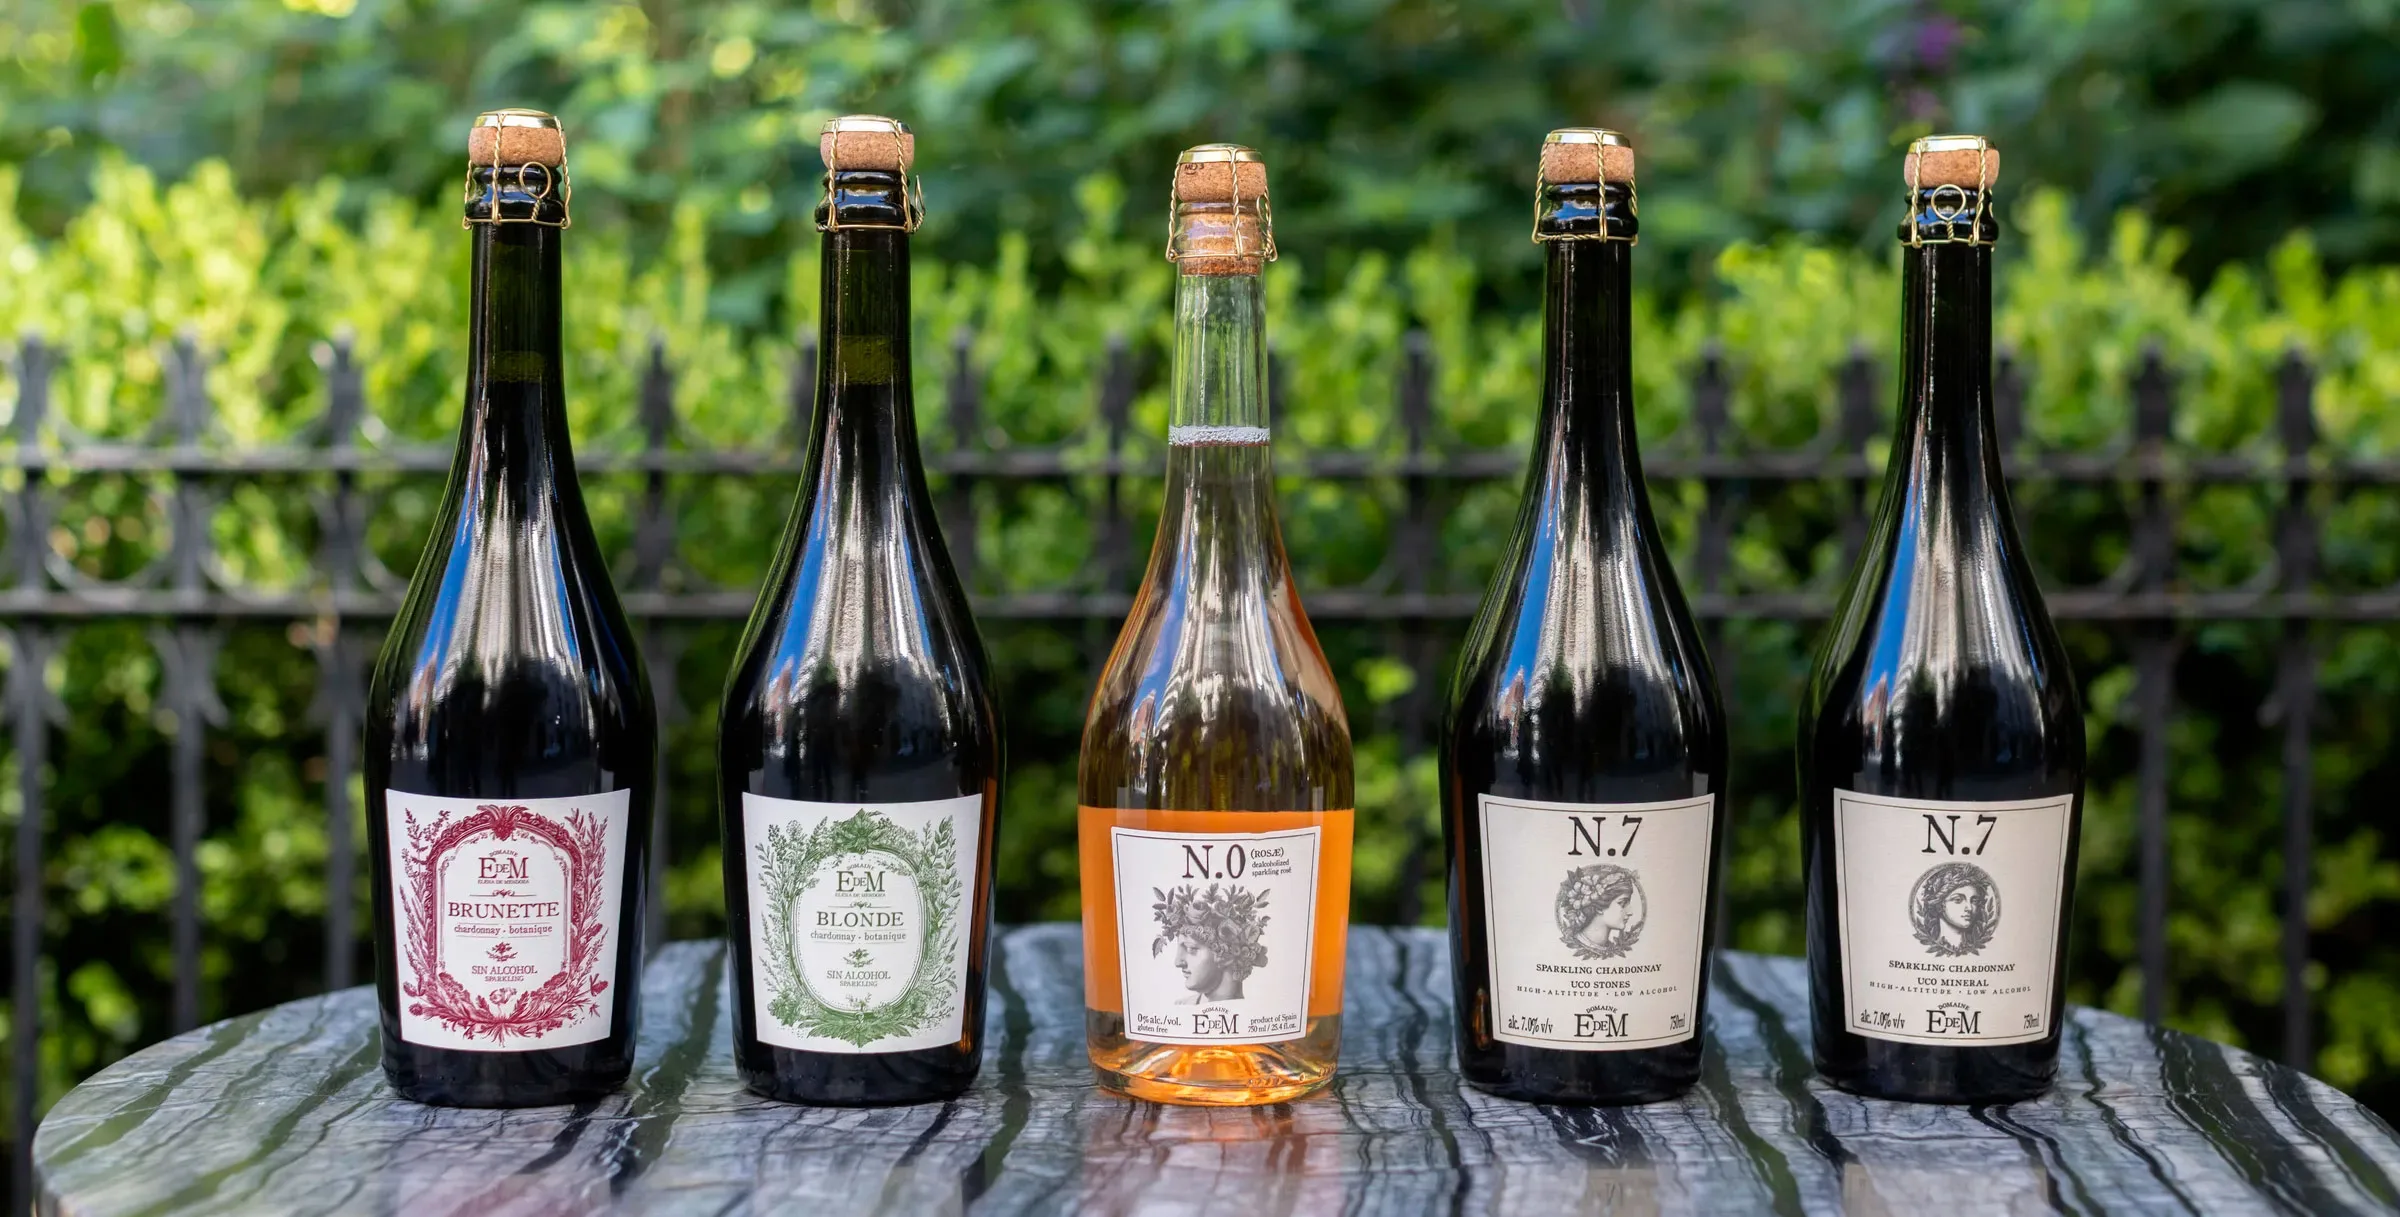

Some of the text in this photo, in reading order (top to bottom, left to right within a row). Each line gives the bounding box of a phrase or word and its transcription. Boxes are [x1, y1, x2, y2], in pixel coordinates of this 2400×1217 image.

[1568, 814, 1642, 857] N.7
[1921, 814, 1997, 855] N.7
[1182, 844, 1246, 879] N.0
[1252, 859, 1290, 868] dealcoholized
[1252, 868, 1280, 877] sparkling
[448, 902, 559, 919] BRUNETTE
[816, 911, 904, 928] BLONDE
[454, 925, 553, 936] chardonnay botanique
[810, 931, 906, 942] chardonnay botanique
[471, 965, 538, 975] SIN ALCOHOL
[1536, 964, 1662, 975] SPARKLING CHARDONNAY
[1889, 960, 2015, 972] SPARKLING CHARDONNAY
[826, 970, 891, 980] SIN ALCOHOL
[1571, 981, 1631, 989] UCO STONES
[1917, 977, 1989, 987] UCO MINERAL
[1640, 985, 1678, 996] ALCOHOL
[1992, 986, 2031, 995] ALCOHOL
[1586, 1005, 1617, 1013] DOMAINE
[1938, 1002, 1970, 1011] DOMAINE
[1250, 1013, 1297, 1025] product of Spain
[1137, 1023, 1169, 1034] gluten free
[1248, 1025, 1258, 1033] 750
